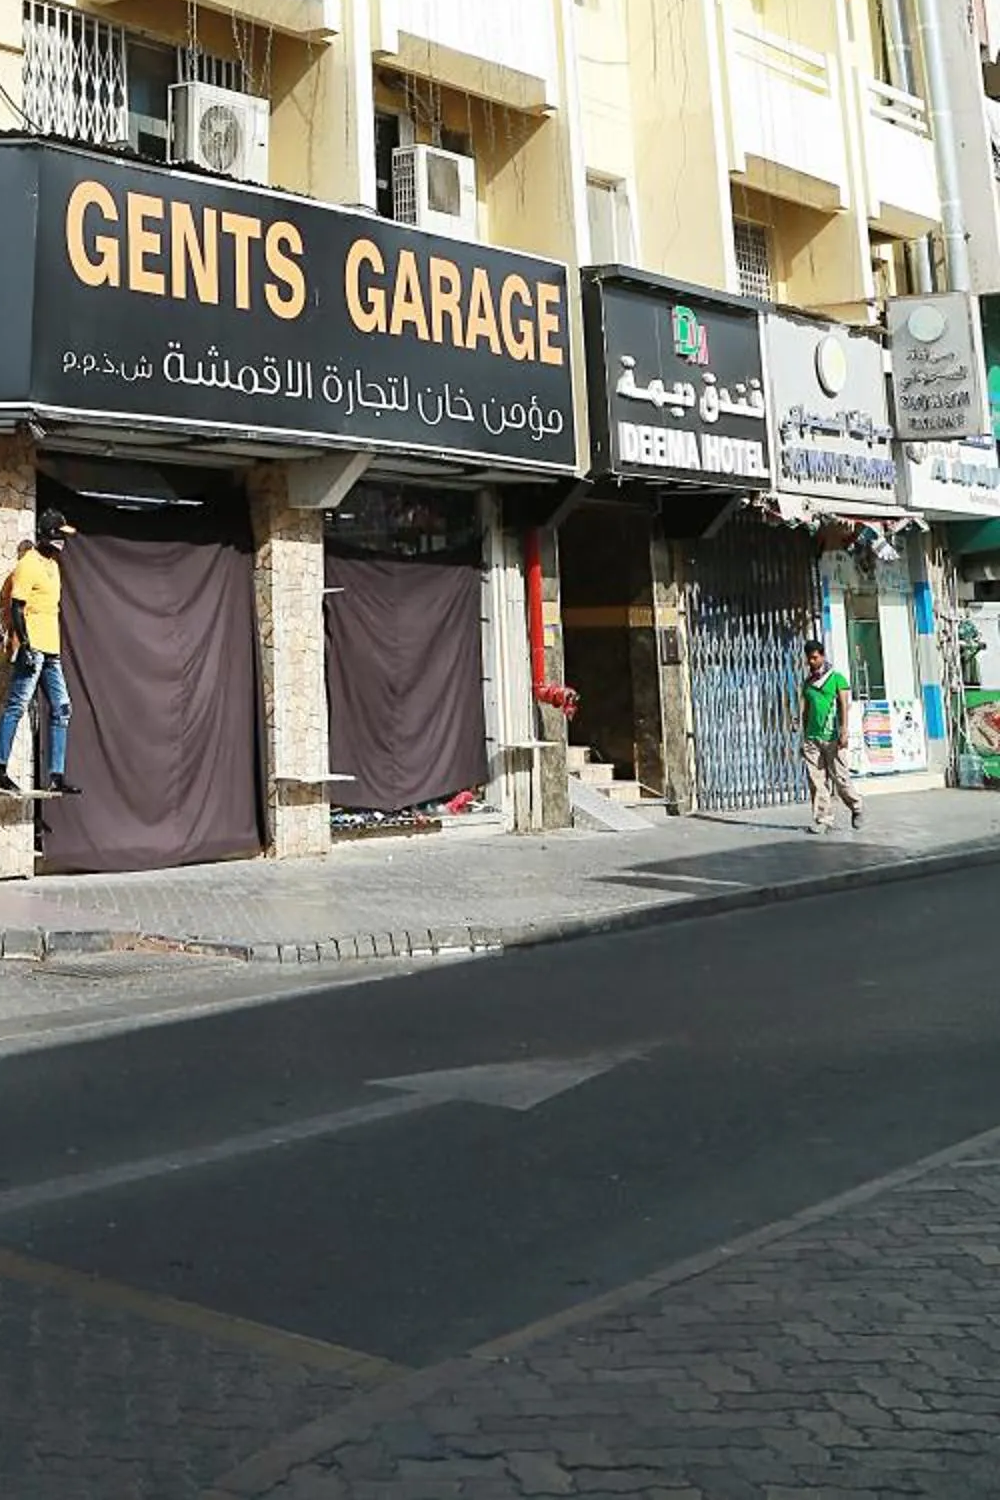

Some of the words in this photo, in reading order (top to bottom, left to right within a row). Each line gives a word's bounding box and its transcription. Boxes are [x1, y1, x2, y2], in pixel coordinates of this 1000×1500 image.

[65, 180, 306, 320] GENTS
[344, 238, 564, 366] GARAGE
[162, 341, 313, 400] الاقمشة
[322, 364, 410, 417] لتجارة
[616, 355, 696, 418] ديمة
[700, 372, 765, 423] فندق
[417, 384, 475, 425] خان
[481, 395, 564, 441] مؤمن
[618, 421, 700, 471] DEEMA
[701, 432, 770, 479] HOTEL
